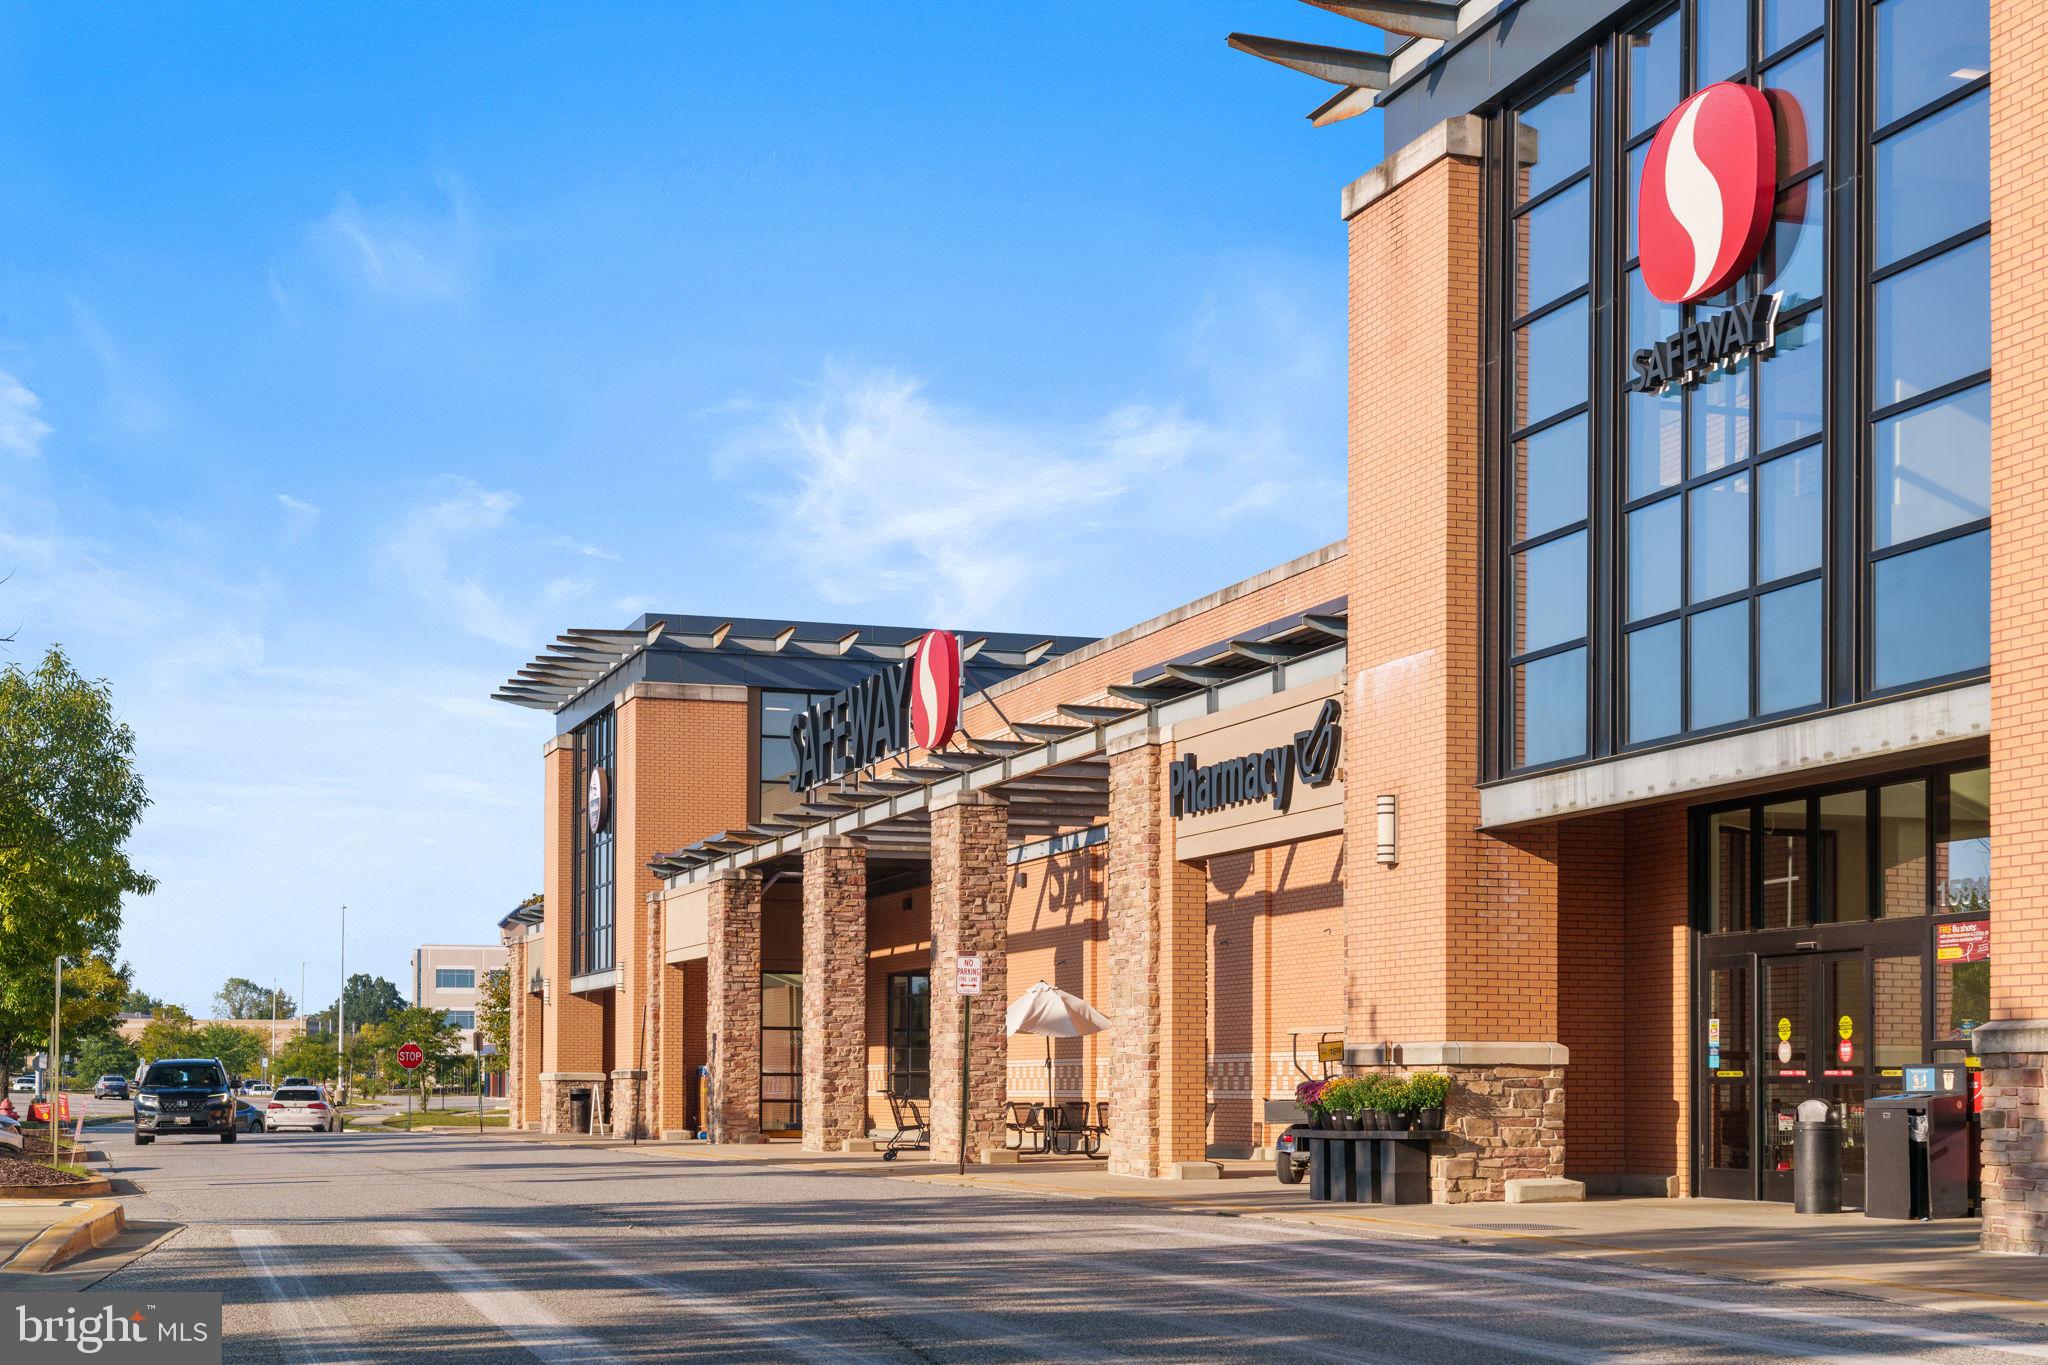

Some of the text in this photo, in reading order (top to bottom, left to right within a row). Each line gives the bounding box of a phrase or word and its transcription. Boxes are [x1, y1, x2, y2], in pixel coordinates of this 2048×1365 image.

[1632, 293, 1773, 392] SAFEWAY
[789, 657, 911, 792] SAFEWAY
[1169, 745, 1293, 817] Pharmacy
[964, 959, 973, 967] NO
[399, 1051, 422, 1061] STOP
